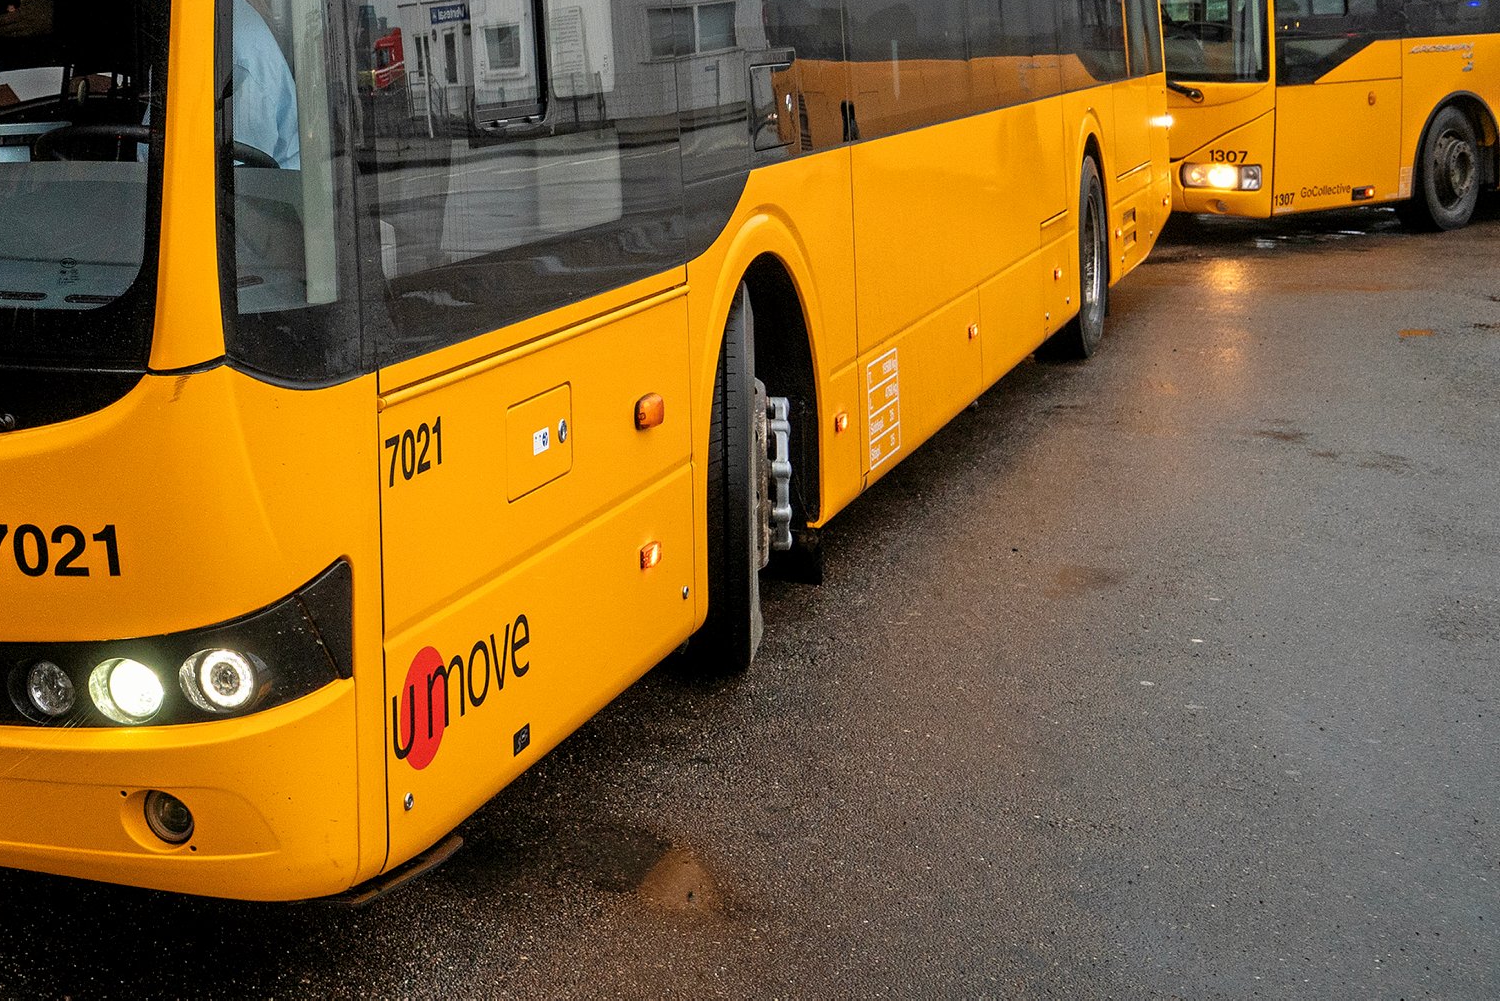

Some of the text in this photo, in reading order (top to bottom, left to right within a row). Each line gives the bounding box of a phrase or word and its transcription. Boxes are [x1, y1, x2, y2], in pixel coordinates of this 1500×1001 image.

[1209, 150, 1248, 163] 1307
[1300, 184, 1351, 198] GoCollective
[1274, 193, 1295, 207] 1307
[385, 416, 442, 488] 7021
